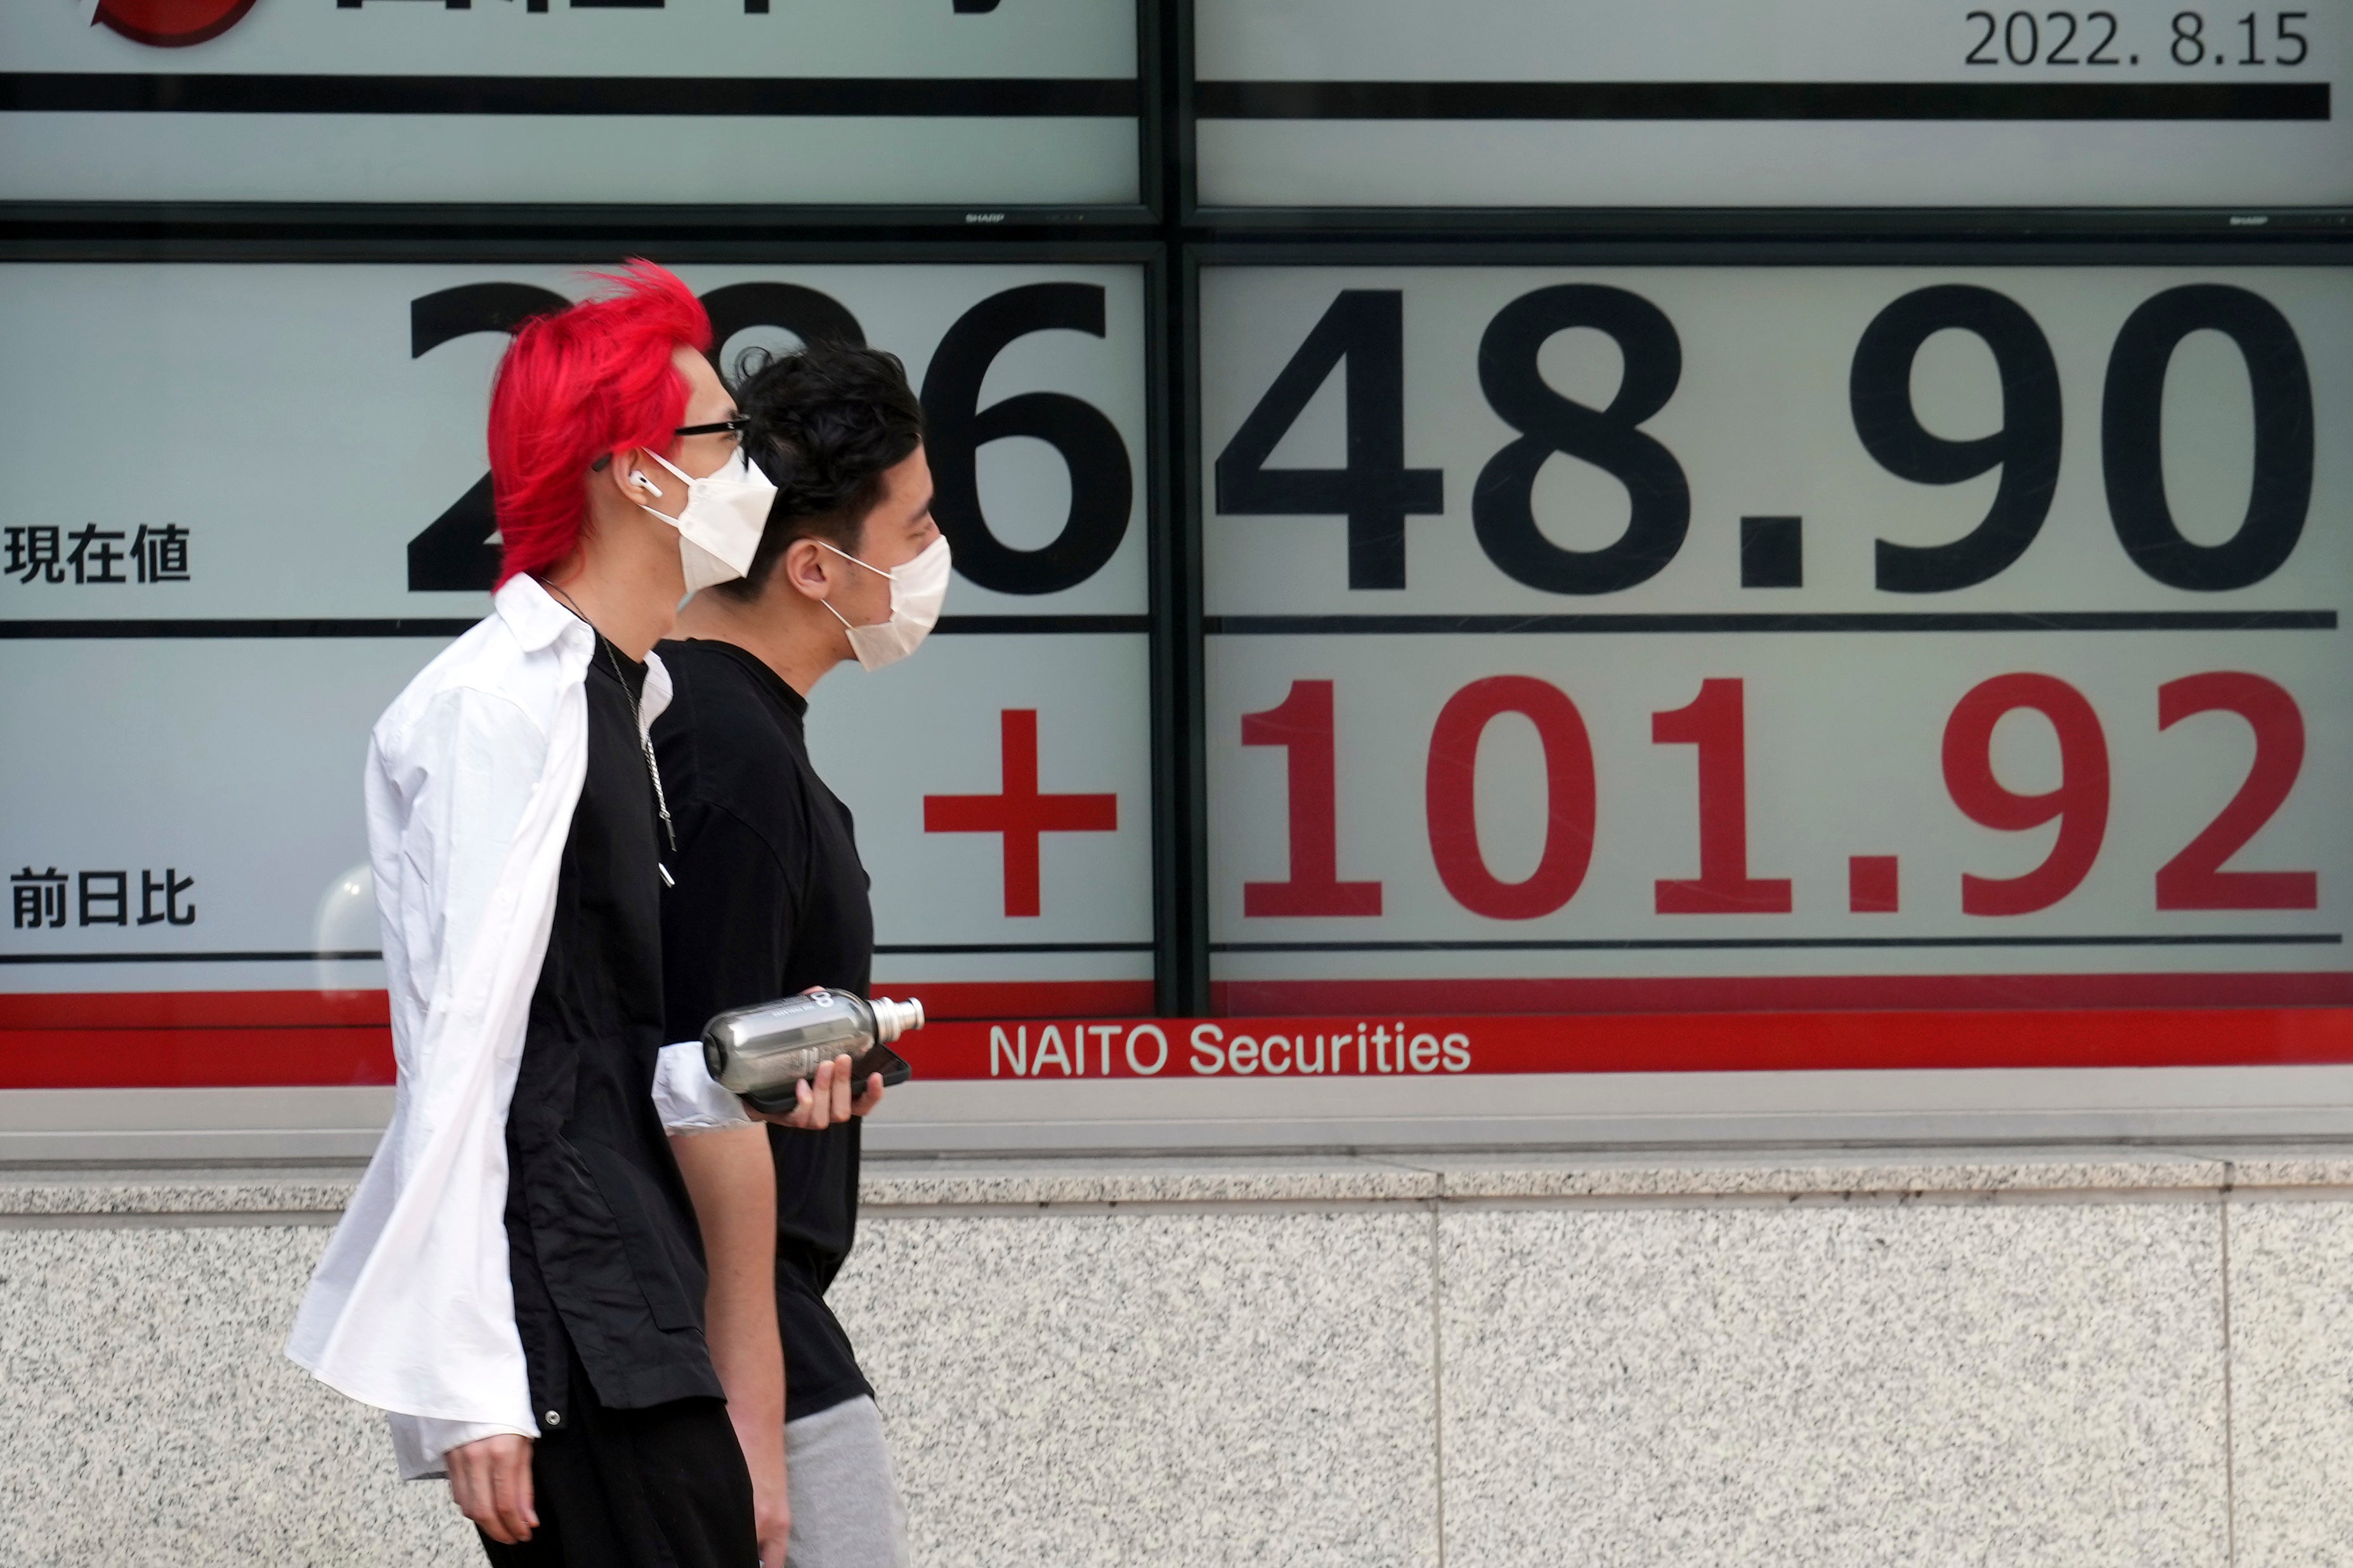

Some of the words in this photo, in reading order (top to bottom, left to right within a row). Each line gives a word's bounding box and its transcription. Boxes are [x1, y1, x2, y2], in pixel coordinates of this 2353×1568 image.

[966, 214, 1005, 223] SHARP
[4, 522, 191, 585] 現在値
[10, 866, 196, 929] 前日比
[989, 1023, 1168, 1077] NAITO
[1189, 1022, 1471, 1075] Securities
